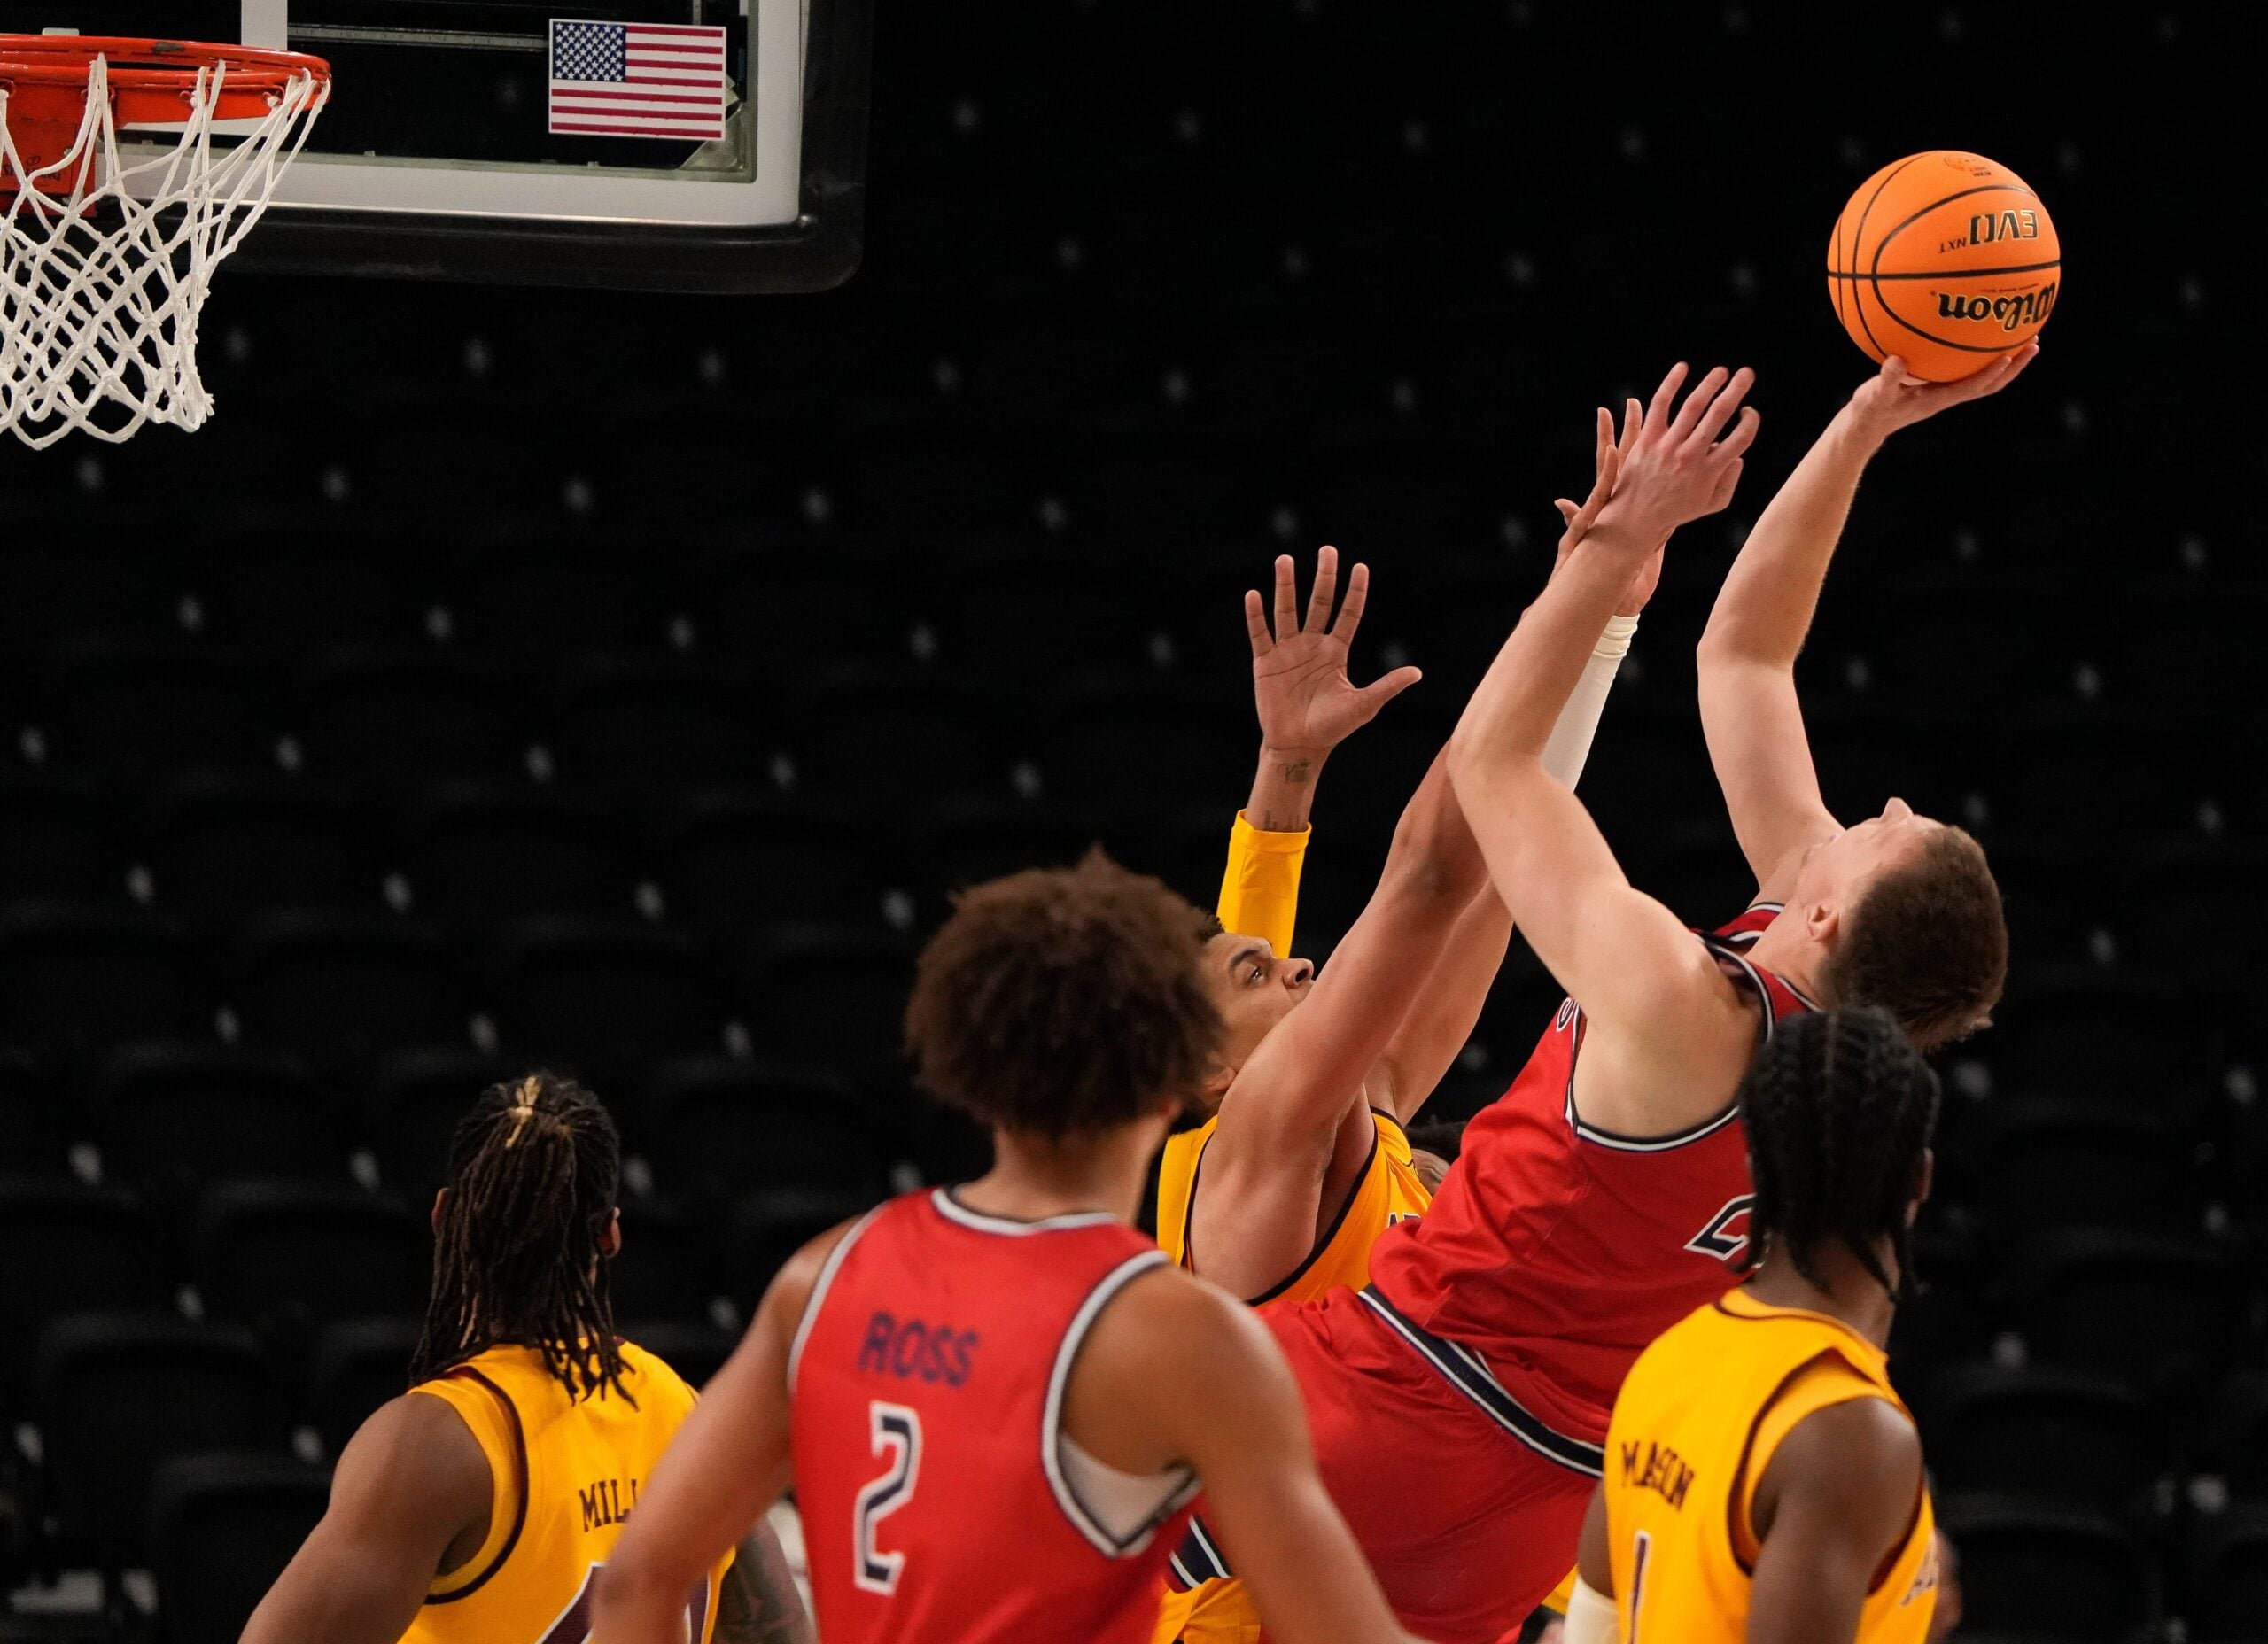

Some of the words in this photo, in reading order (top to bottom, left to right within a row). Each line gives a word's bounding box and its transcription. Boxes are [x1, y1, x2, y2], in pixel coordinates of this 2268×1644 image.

[1938, 237, 1968, 254] NXT
[1938, 280, 2056, 332] Wilson
[856, 1310, 981, 1388] ROSS
[854, 1400, 923, 1596] 2
[1627, 1529, 1651, 1644] 1
